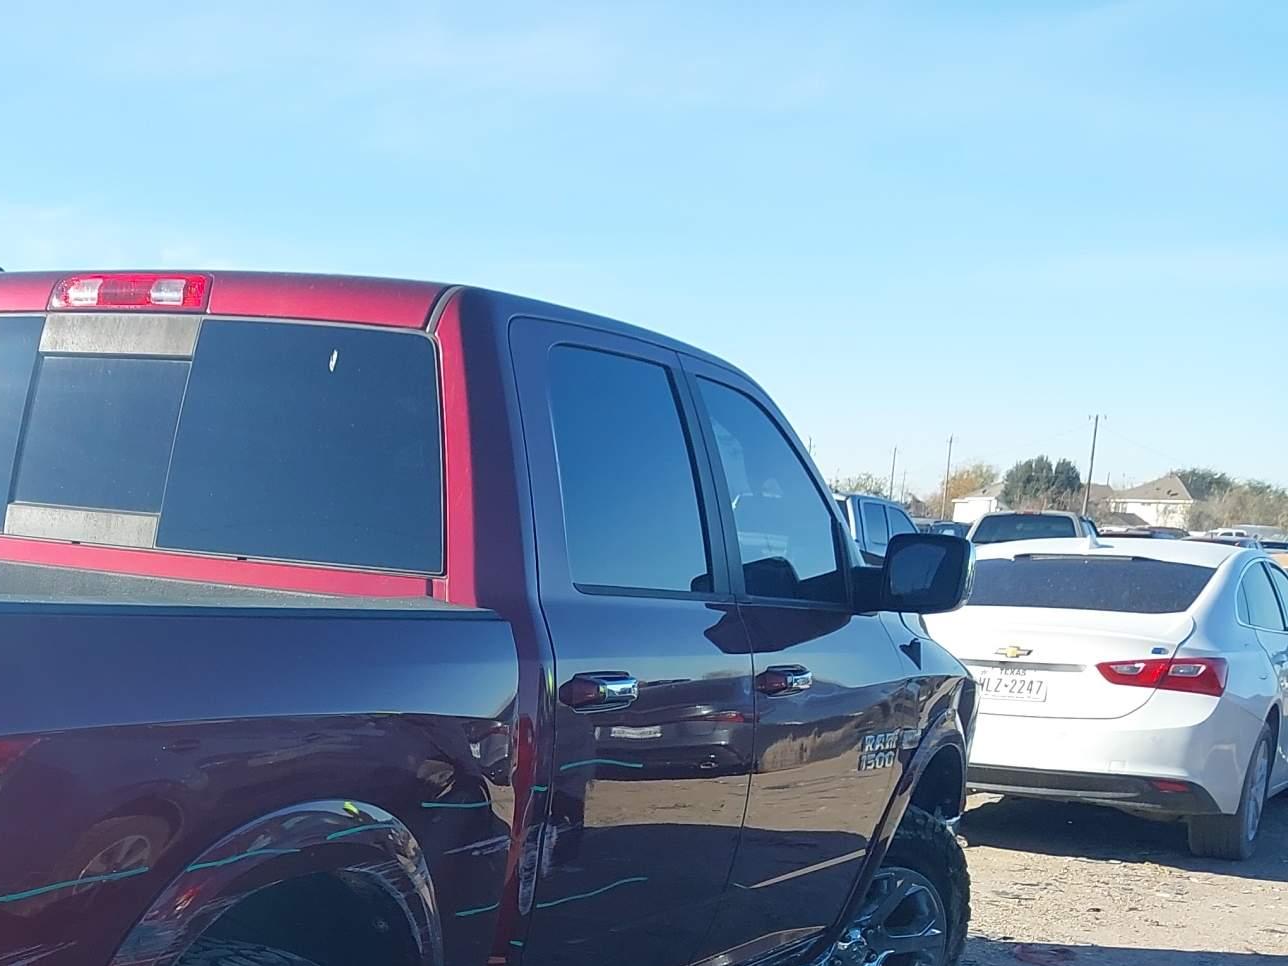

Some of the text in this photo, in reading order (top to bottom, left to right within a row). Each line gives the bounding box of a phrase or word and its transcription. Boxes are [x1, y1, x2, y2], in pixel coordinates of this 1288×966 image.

[998, 668, 1027, 677] TEXAS
[863, 733, 899, 752] RAM
[858, 750, 895, 771] 1500
